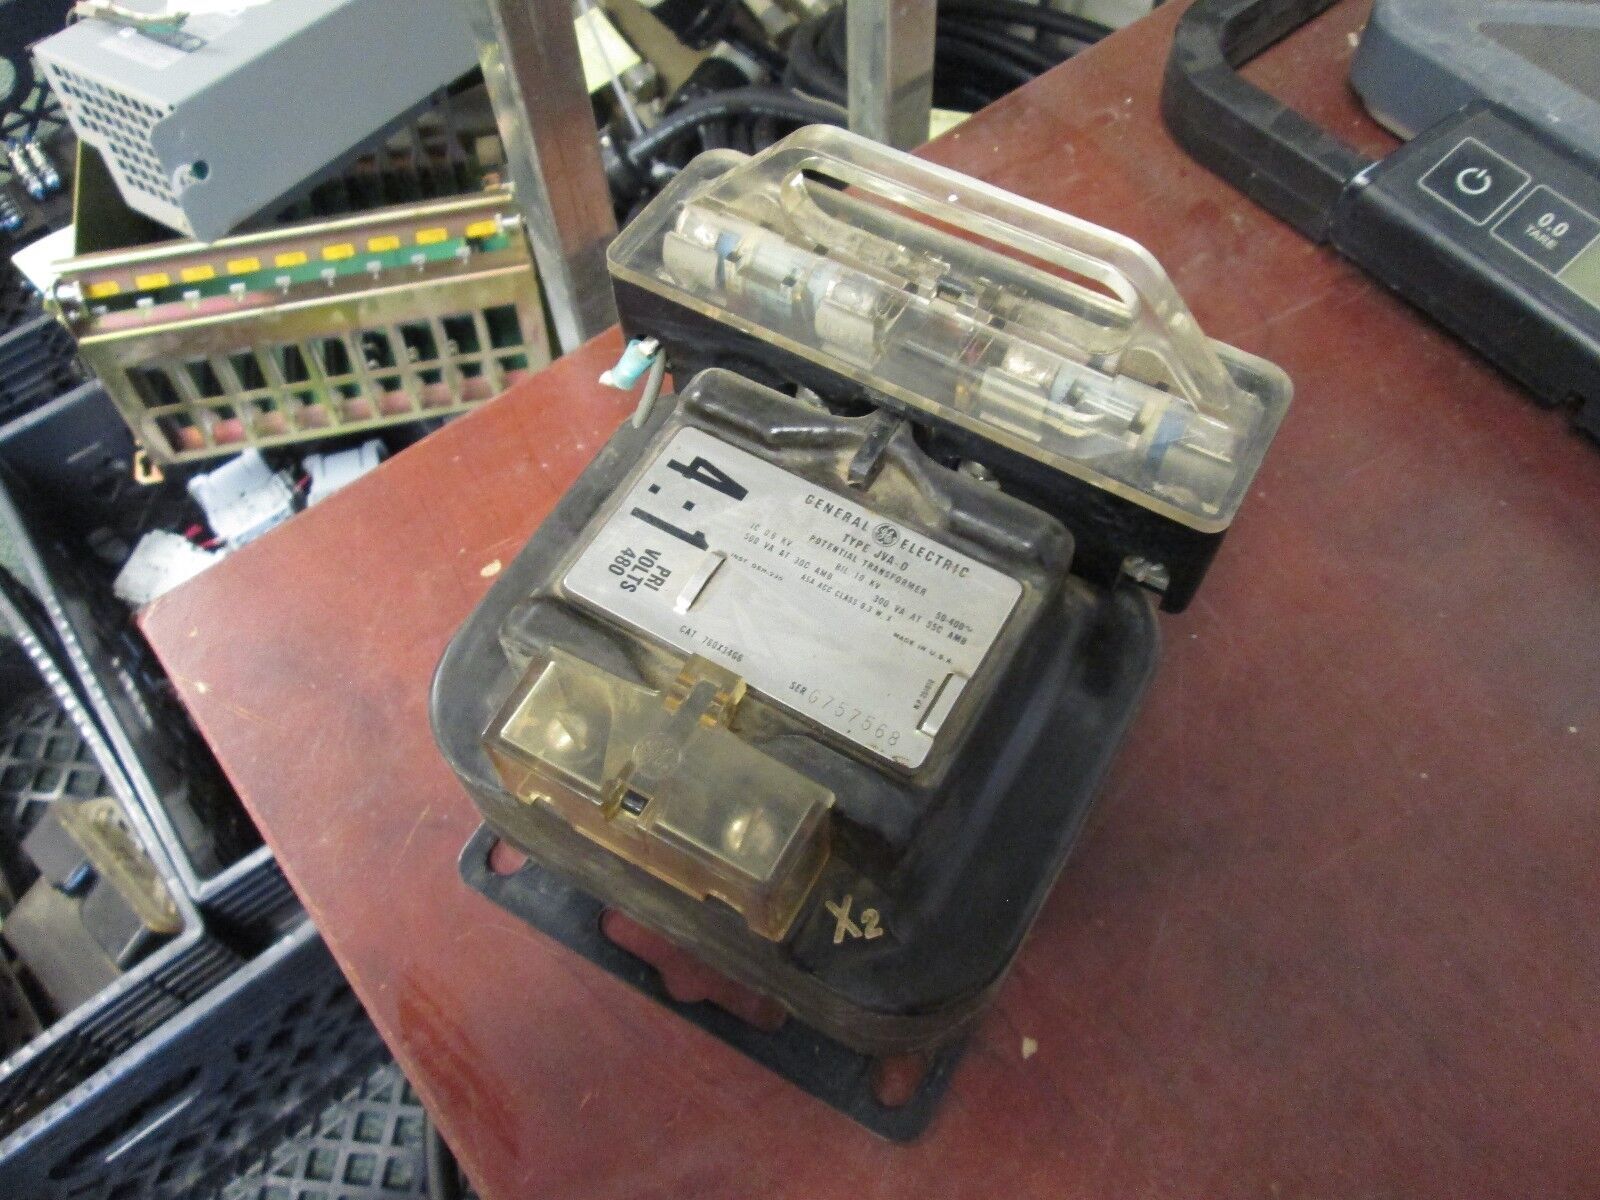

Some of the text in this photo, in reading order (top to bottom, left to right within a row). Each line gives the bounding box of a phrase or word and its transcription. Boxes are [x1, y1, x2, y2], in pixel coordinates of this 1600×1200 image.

[1538, 212, 1569, 237] 0.0
[630, 456, 749, 551] 4:1
[804, 494, 870, 531] GENERAL
[900, 539, 970, 577] ELECTRIC
[841, 533, 871, 553] TYPE
[605, 544, 639, 577] 480
[618, 546, 662, 594] VOLTS
[643, 564, 672, 591] PRI
[779, 536, 793, 547] KV
[852, 571, 866, 582] 10
[868, 578, 881, 589] KV
[808, 534, 928, 596] POTENTIAL TRANSFORMER
[742, 532, 760, 545] 500
[762, 541, 775, 552] VA
[777, 549, 790, 559] AT
[813, 566, 833, 580] AMB
[871, 594, 890, 608] 300
[892, 604, 906, 616] VA
[908, 612, 922, 623] AT
[947, 631, 968, 646] AMB
[678, 623, 697, 638] CAT
[788, 680, 808, 696] SER
[824, 894, 884, 944] X2
